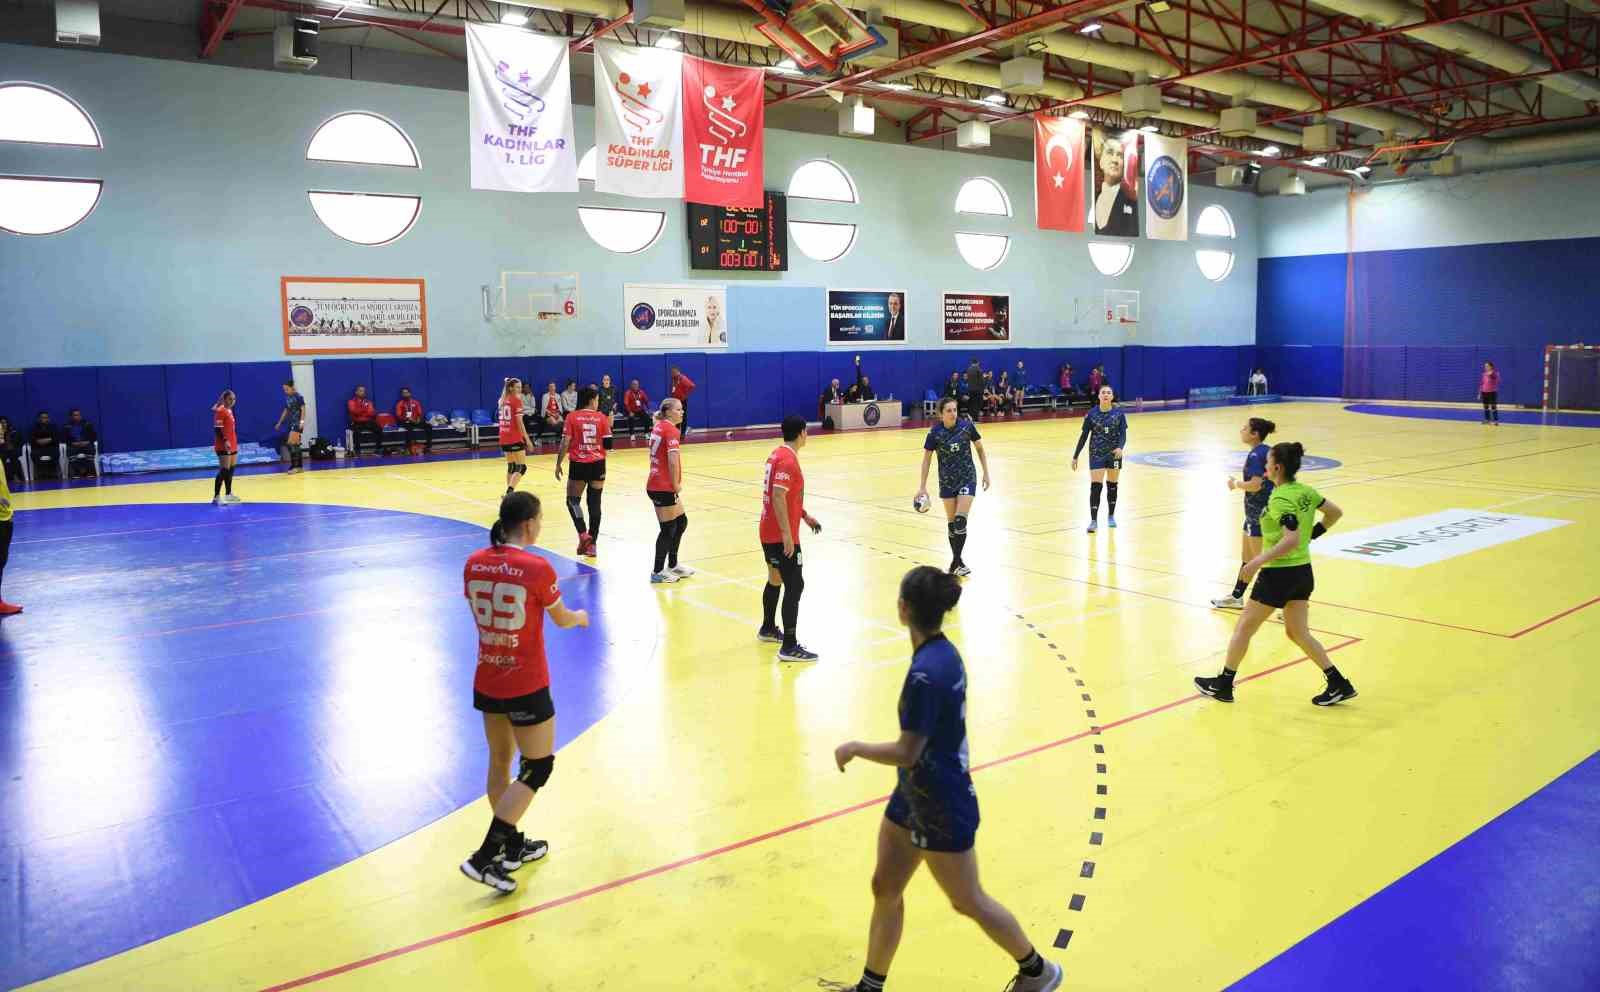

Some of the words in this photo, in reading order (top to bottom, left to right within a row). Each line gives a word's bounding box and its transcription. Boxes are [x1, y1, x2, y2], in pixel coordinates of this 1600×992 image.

[508, 123, 538, 137] THF
[483, 133, 566, 151] KADINLAR
[631, 136, 654, 146] THF
[505, 152, 515, 164] 1.
[608, 144, 671, 159] KADINLAR
[699, 143, 747, 168] THF
[607, 156, 649, 171] SÜPER
[563, 300, 576, 316] 6
[581, 423, 597, 444] 2
[468, 580, 528, 631] 69
